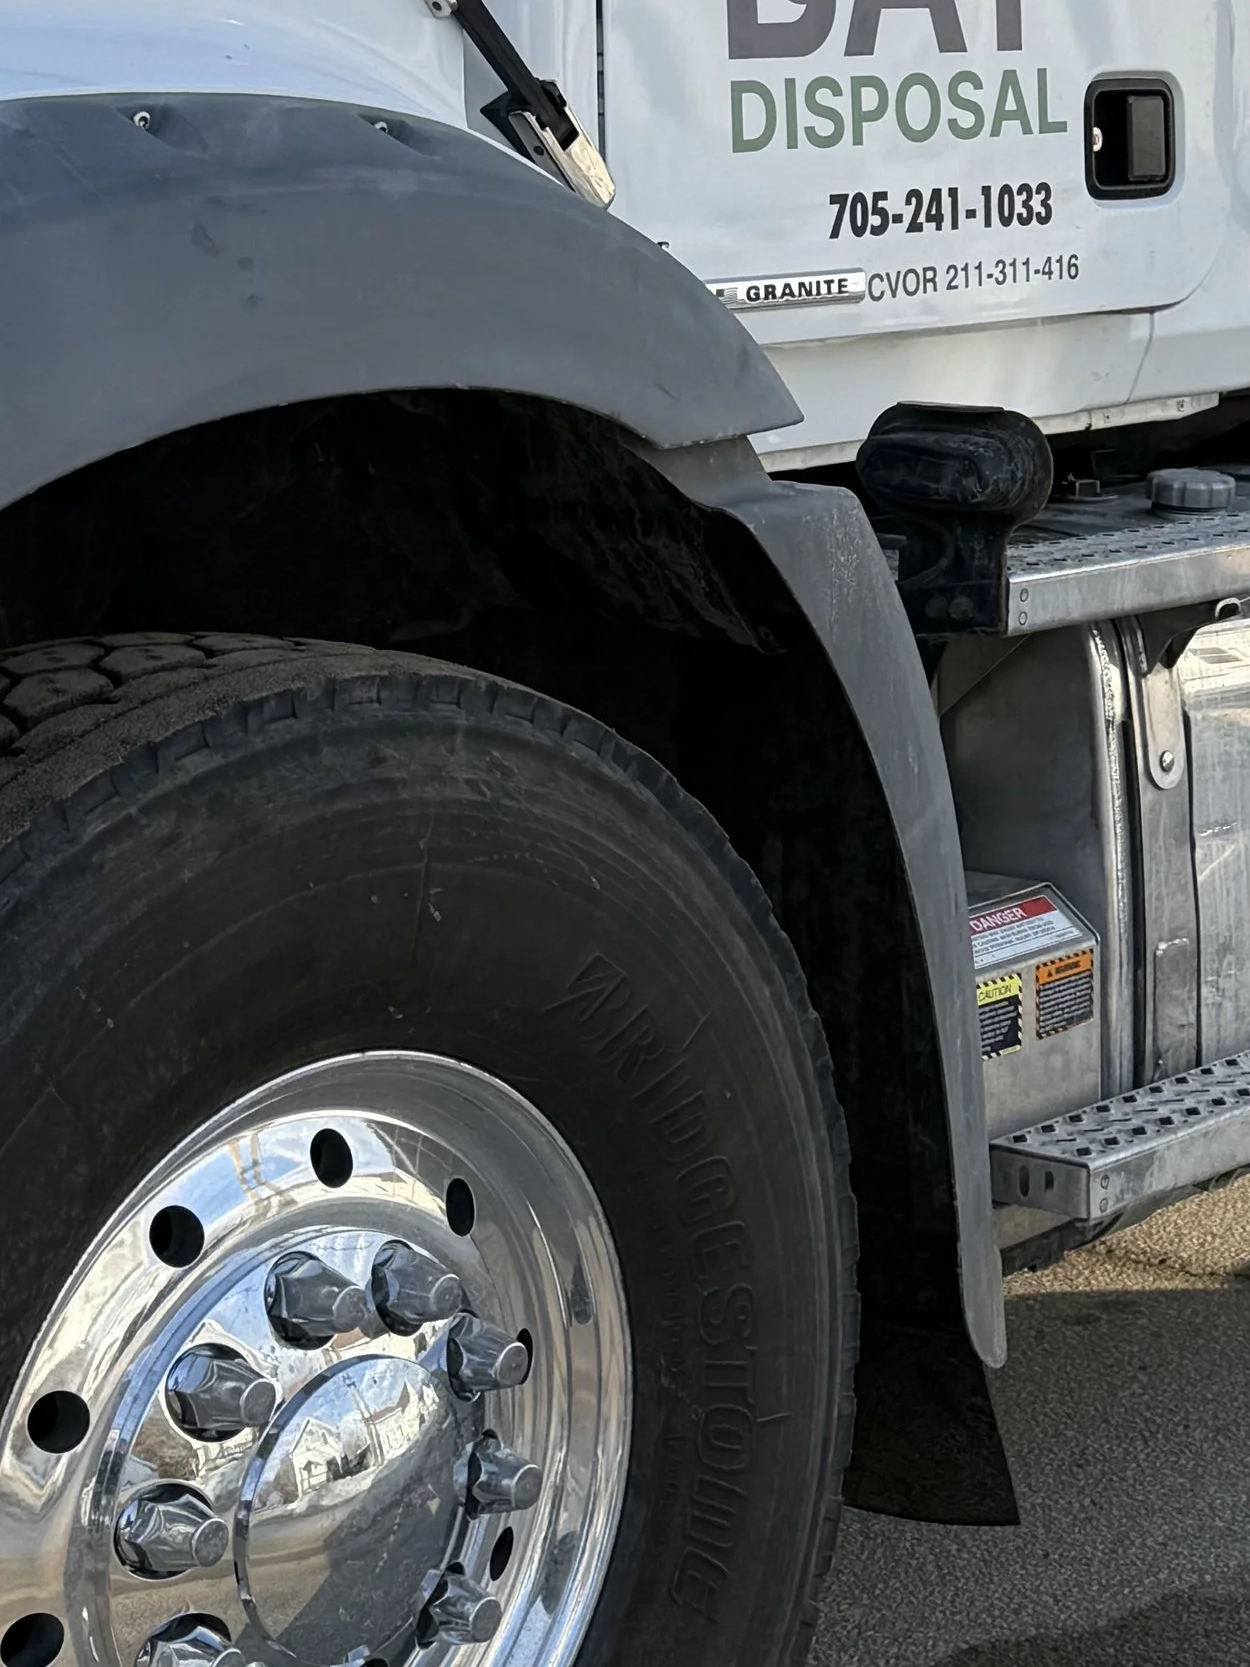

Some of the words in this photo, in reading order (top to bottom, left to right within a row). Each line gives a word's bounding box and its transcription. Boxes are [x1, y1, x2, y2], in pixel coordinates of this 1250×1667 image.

[730, 66, 1069, 154] DISPOSAL
[829, 181, 1054, 240] 705-241-1033
[745, 277, 849, 303] GRANITE
[867, 265, 938, 303] CVOR
[945, 253, 1080, 292] 211-311-416
[968, 907, 1028, 932] DANGER
